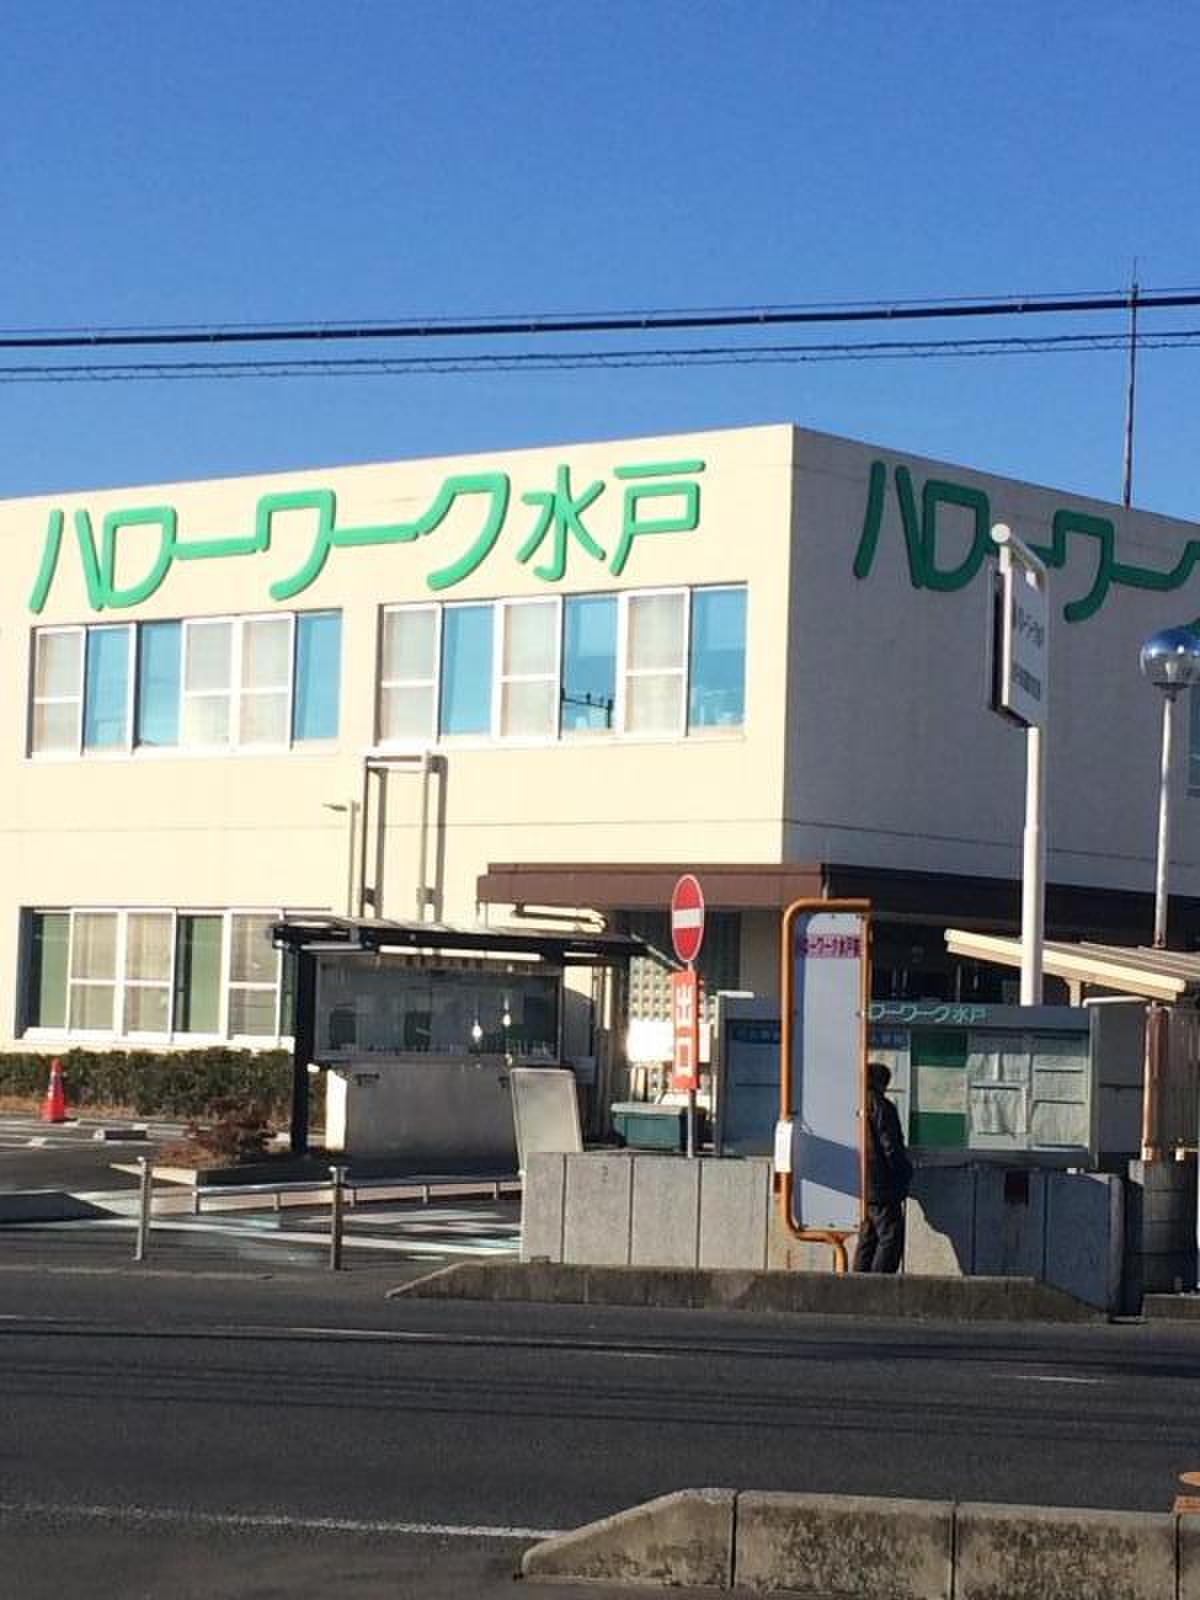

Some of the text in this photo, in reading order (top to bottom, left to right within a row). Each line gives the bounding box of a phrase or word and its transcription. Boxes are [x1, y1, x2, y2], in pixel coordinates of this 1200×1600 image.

[29, 460, 706, 612] ハローワーク水戸
[853, 460, 1200, 622] ハローワー
[675, 984, 693, 1077] 出口
